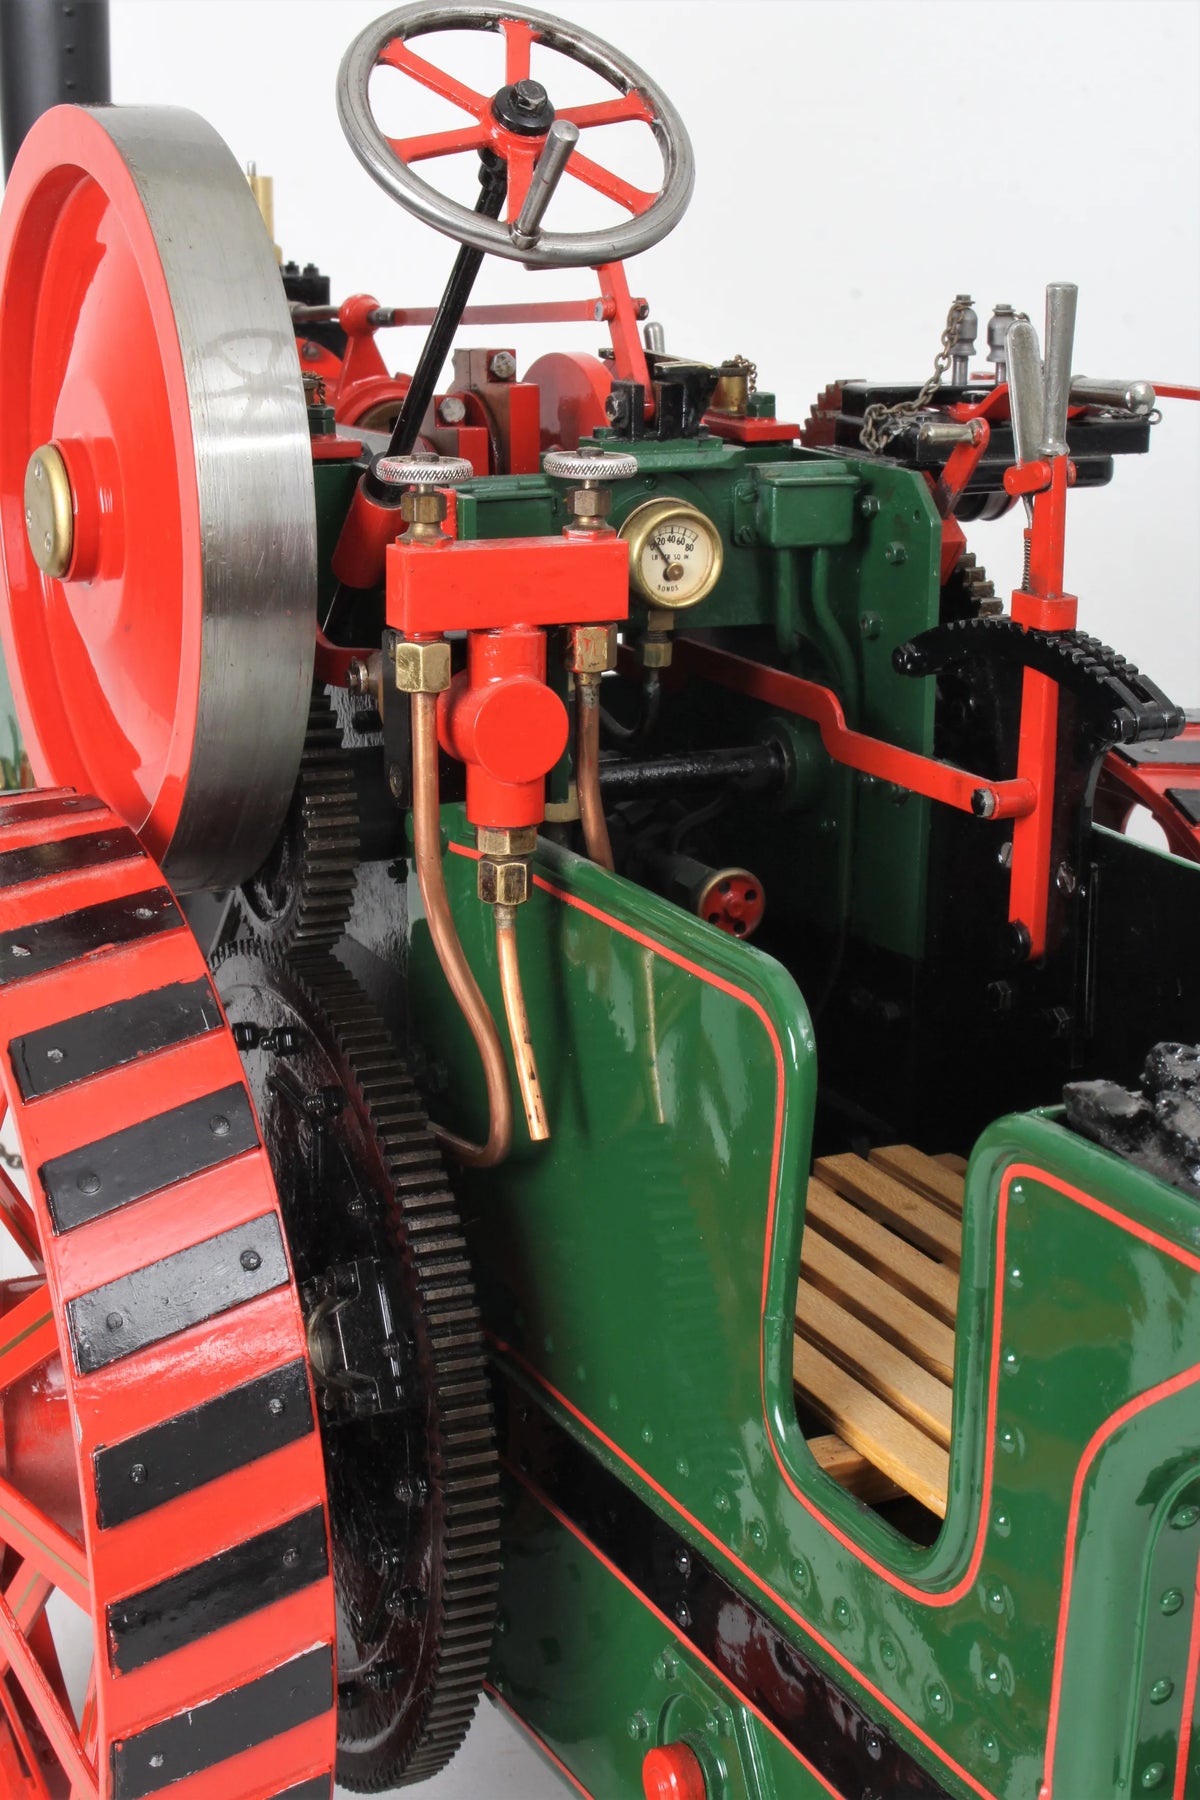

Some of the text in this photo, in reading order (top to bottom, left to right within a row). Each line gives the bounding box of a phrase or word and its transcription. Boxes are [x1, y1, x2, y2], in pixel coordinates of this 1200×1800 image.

[656, 537, 666, 545] 20
[667, 535, 676, 543] 40
[676, 537, 686, 545] 60
[685, 543, 694, 552] 80
